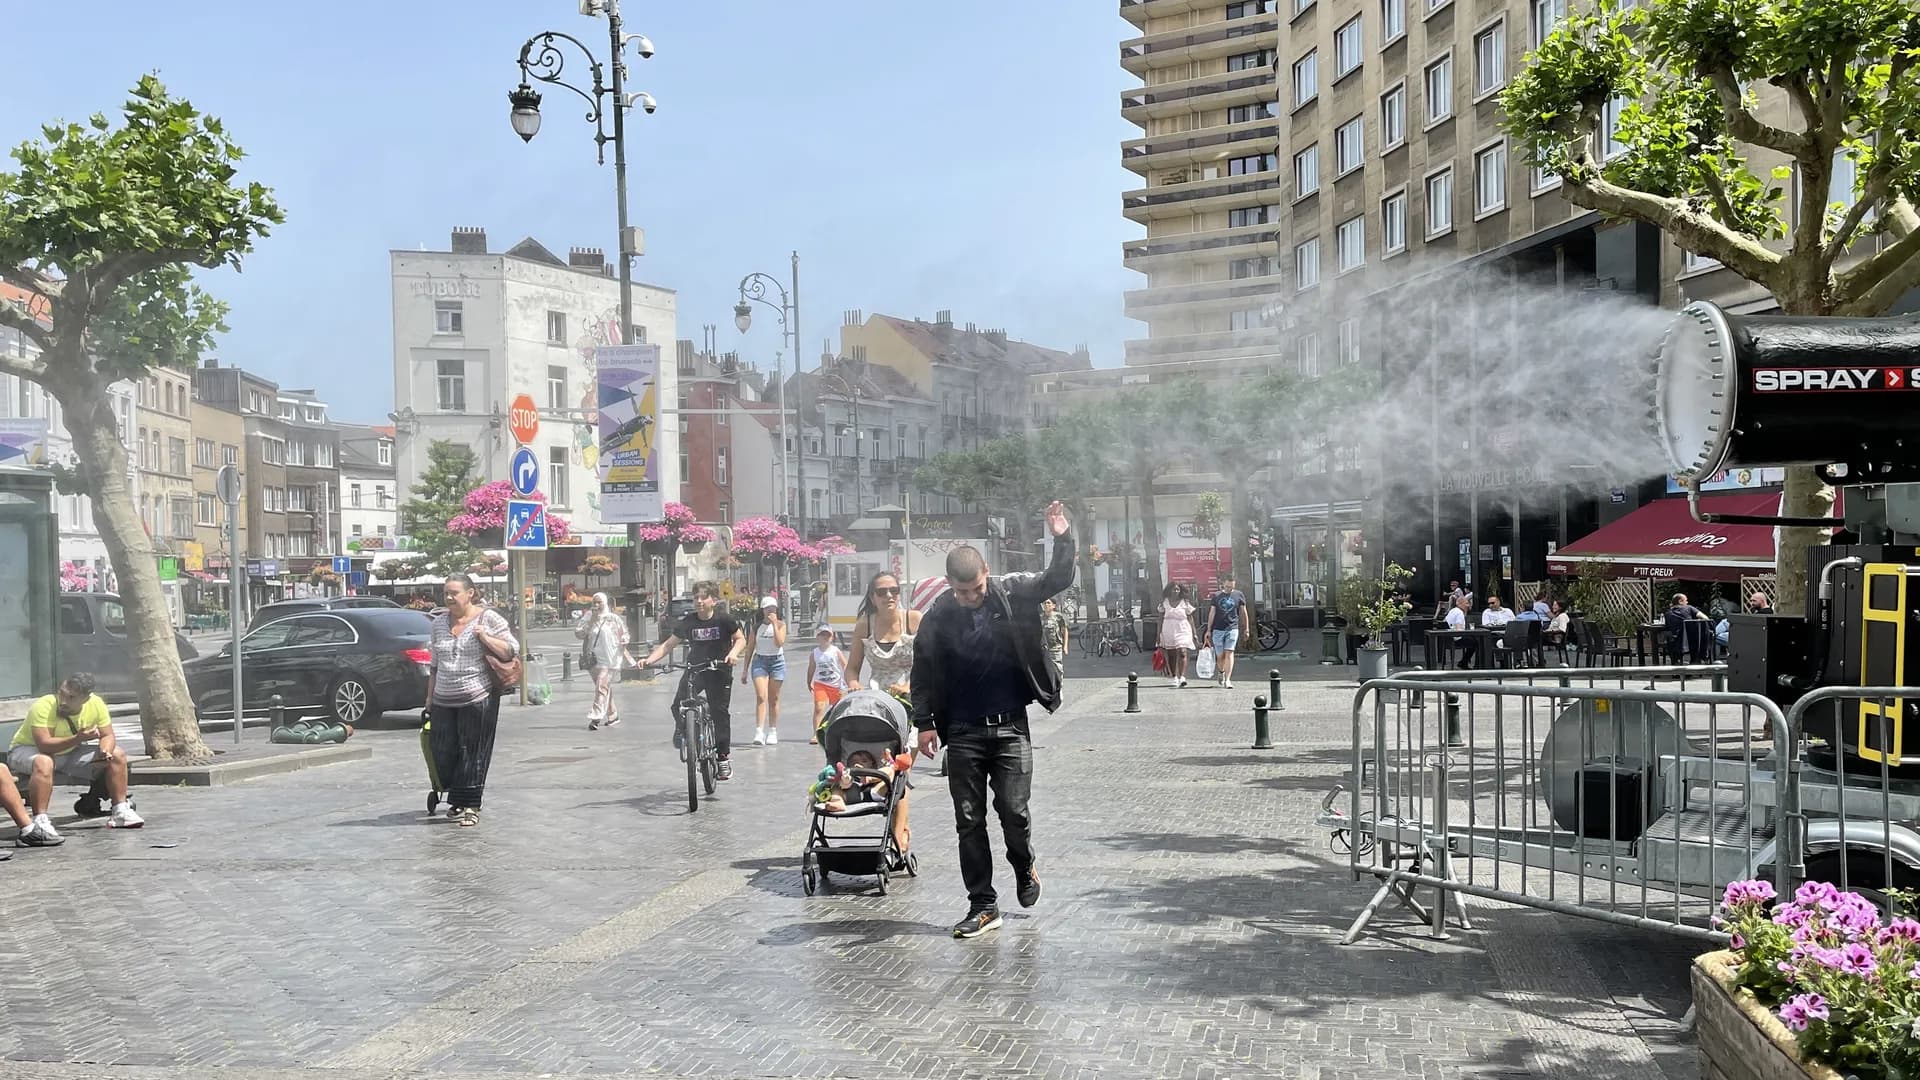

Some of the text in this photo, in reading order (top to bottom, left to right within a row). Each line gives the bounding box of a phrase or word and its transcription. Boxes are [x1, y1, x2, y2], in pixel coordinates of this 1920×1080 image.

[1755, 369, 1877, 390] SPRAY
[513, 408, 537, 430] STOP
[617, 450, 639, 459] URBAN
[1633, 567, 1674, 577] P'TIT CREUX
